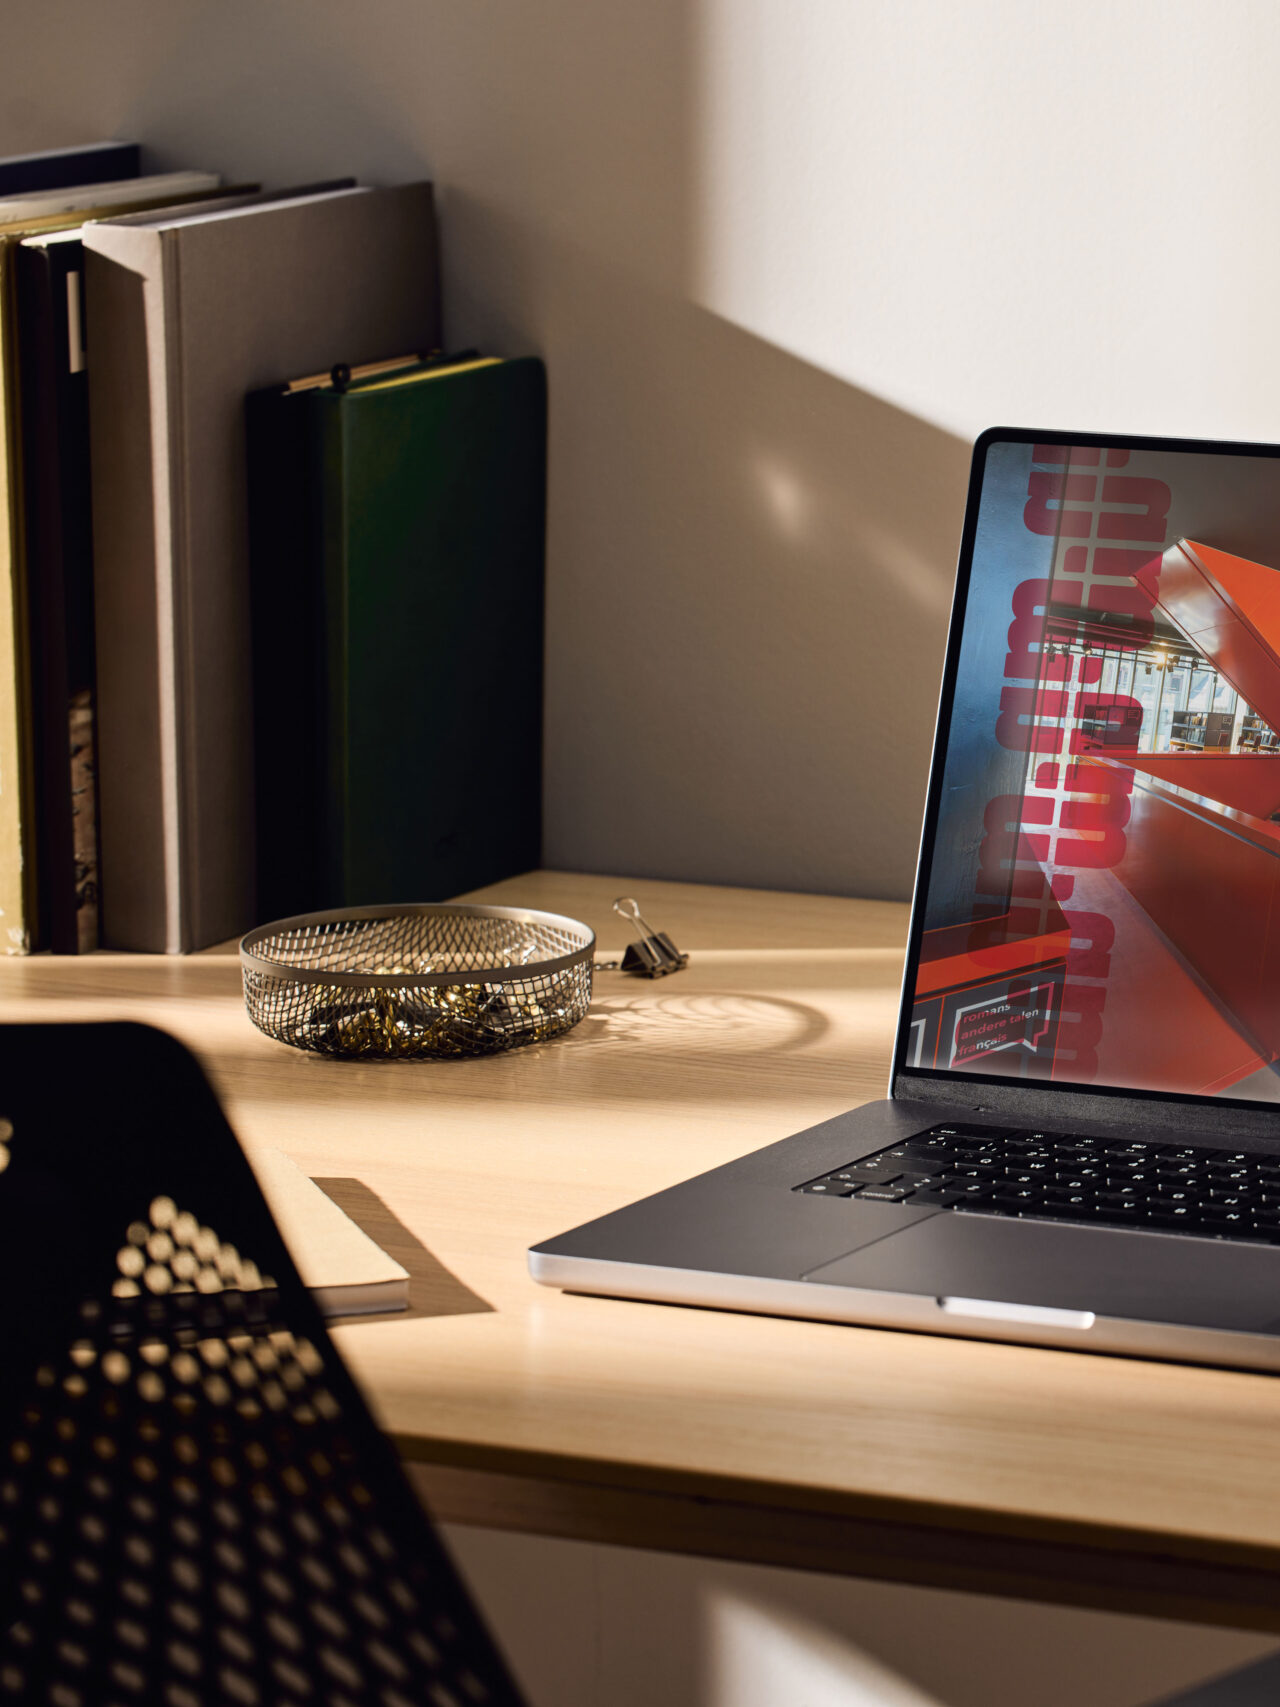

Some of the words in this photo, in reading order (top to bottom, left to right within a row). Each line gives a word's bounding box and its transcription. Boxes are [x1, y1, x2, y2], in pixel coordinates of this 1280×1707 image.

[960, 1019, 1007, 1040] andere
[1009, 1009, 1039, 1024] talen
[962, 1003, 1011, 1024] romans
[959, 1033, 1007, 1056] français
